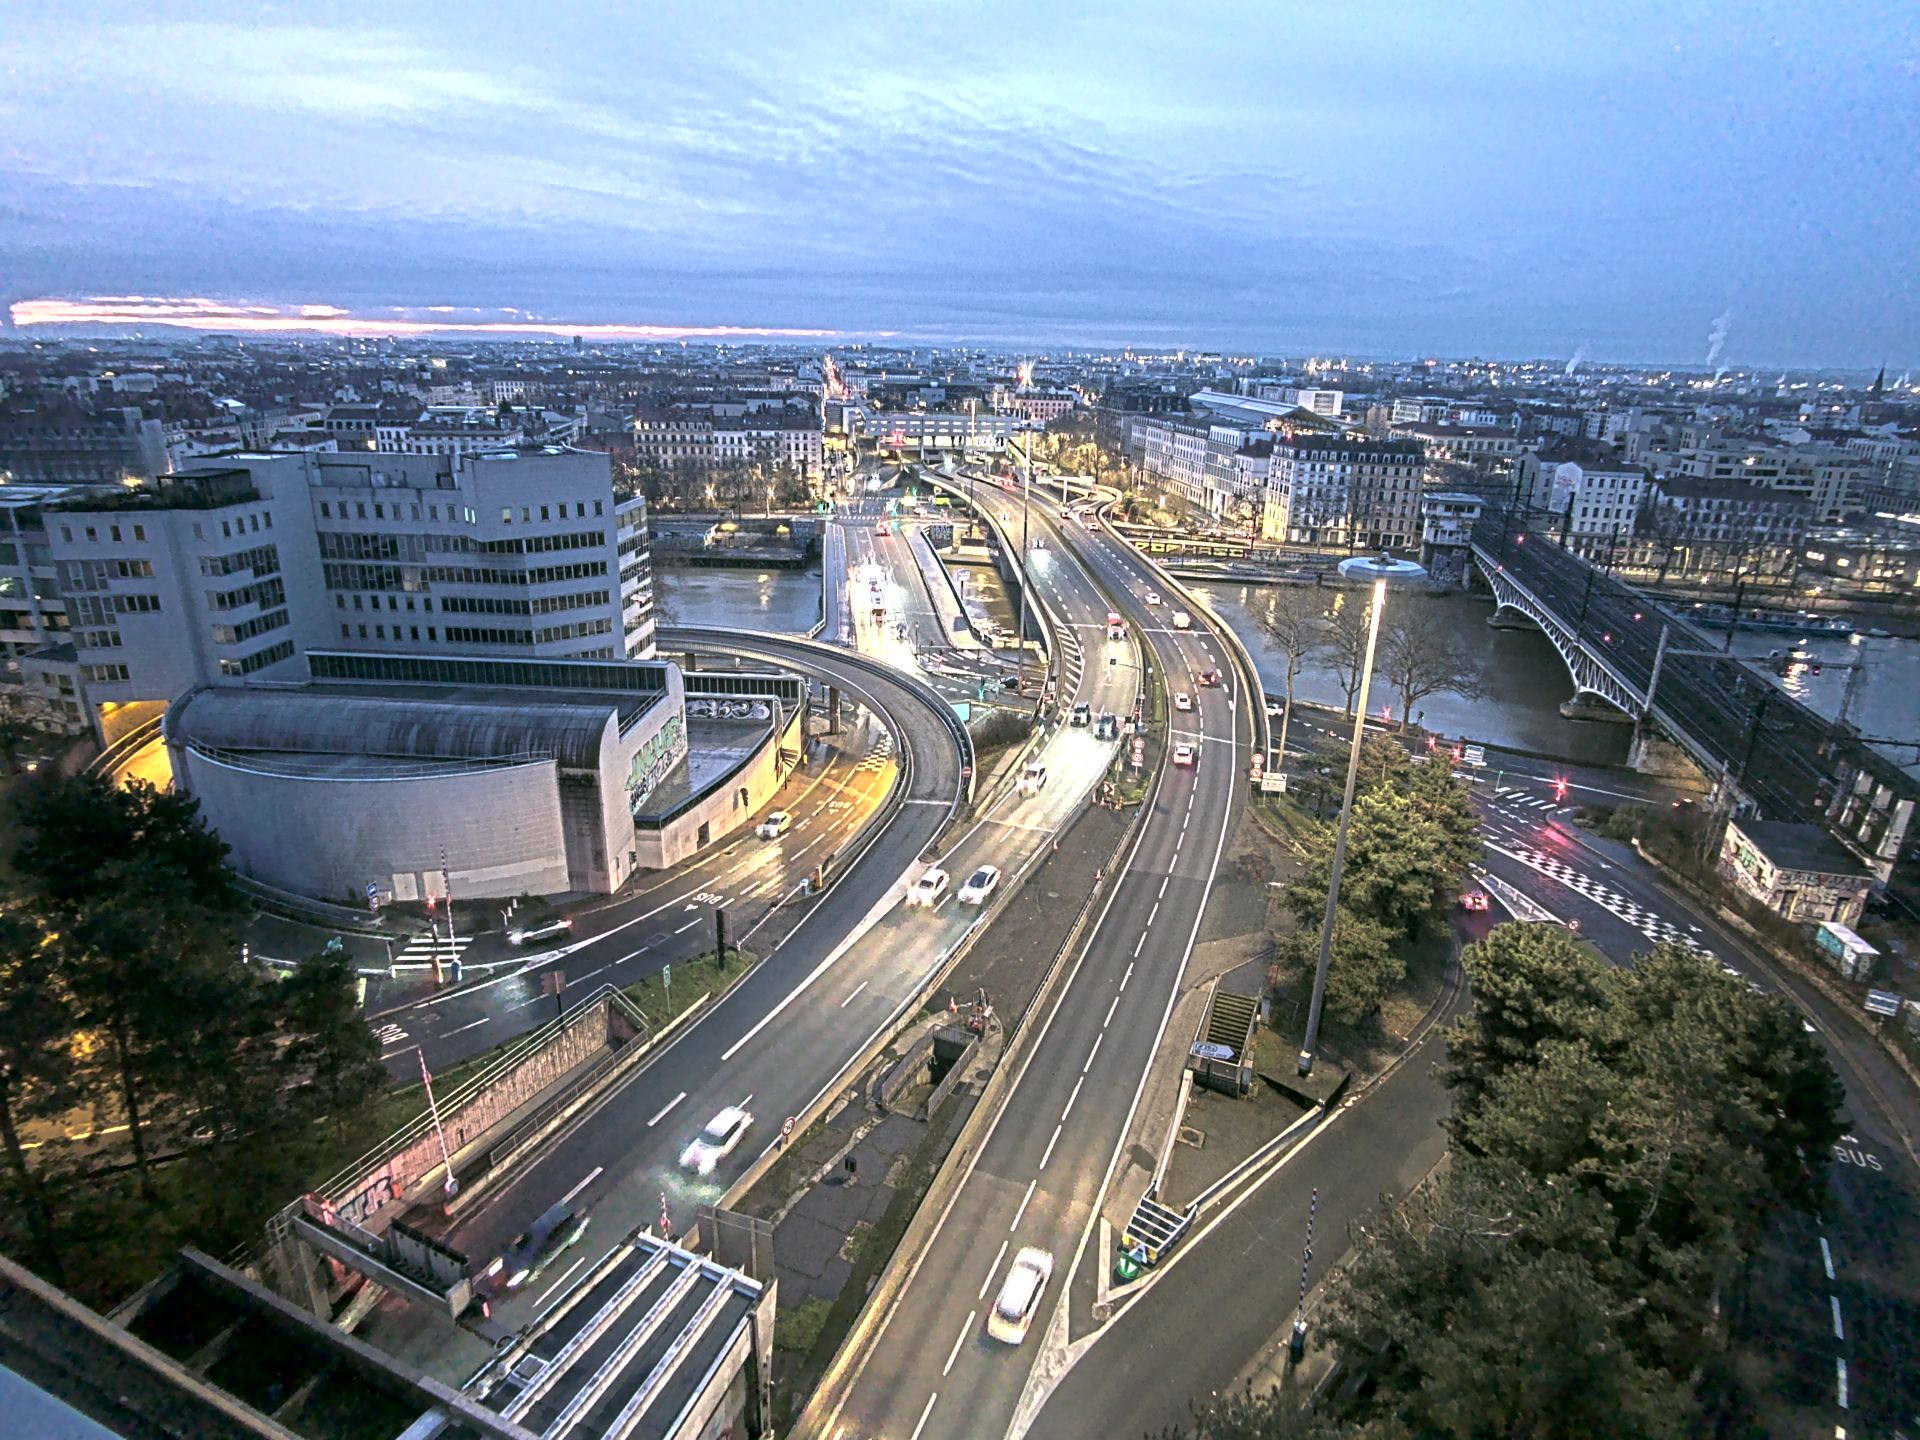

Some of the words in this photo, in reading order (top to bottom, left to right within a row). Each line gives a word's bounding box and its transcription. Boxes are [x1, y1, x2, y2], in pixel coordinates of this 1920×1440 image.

[692, 892, 724, 905] BUS
[376, 1023, 409, 1045] BUS
[1833, 1145, 1882, 1171] BUS
